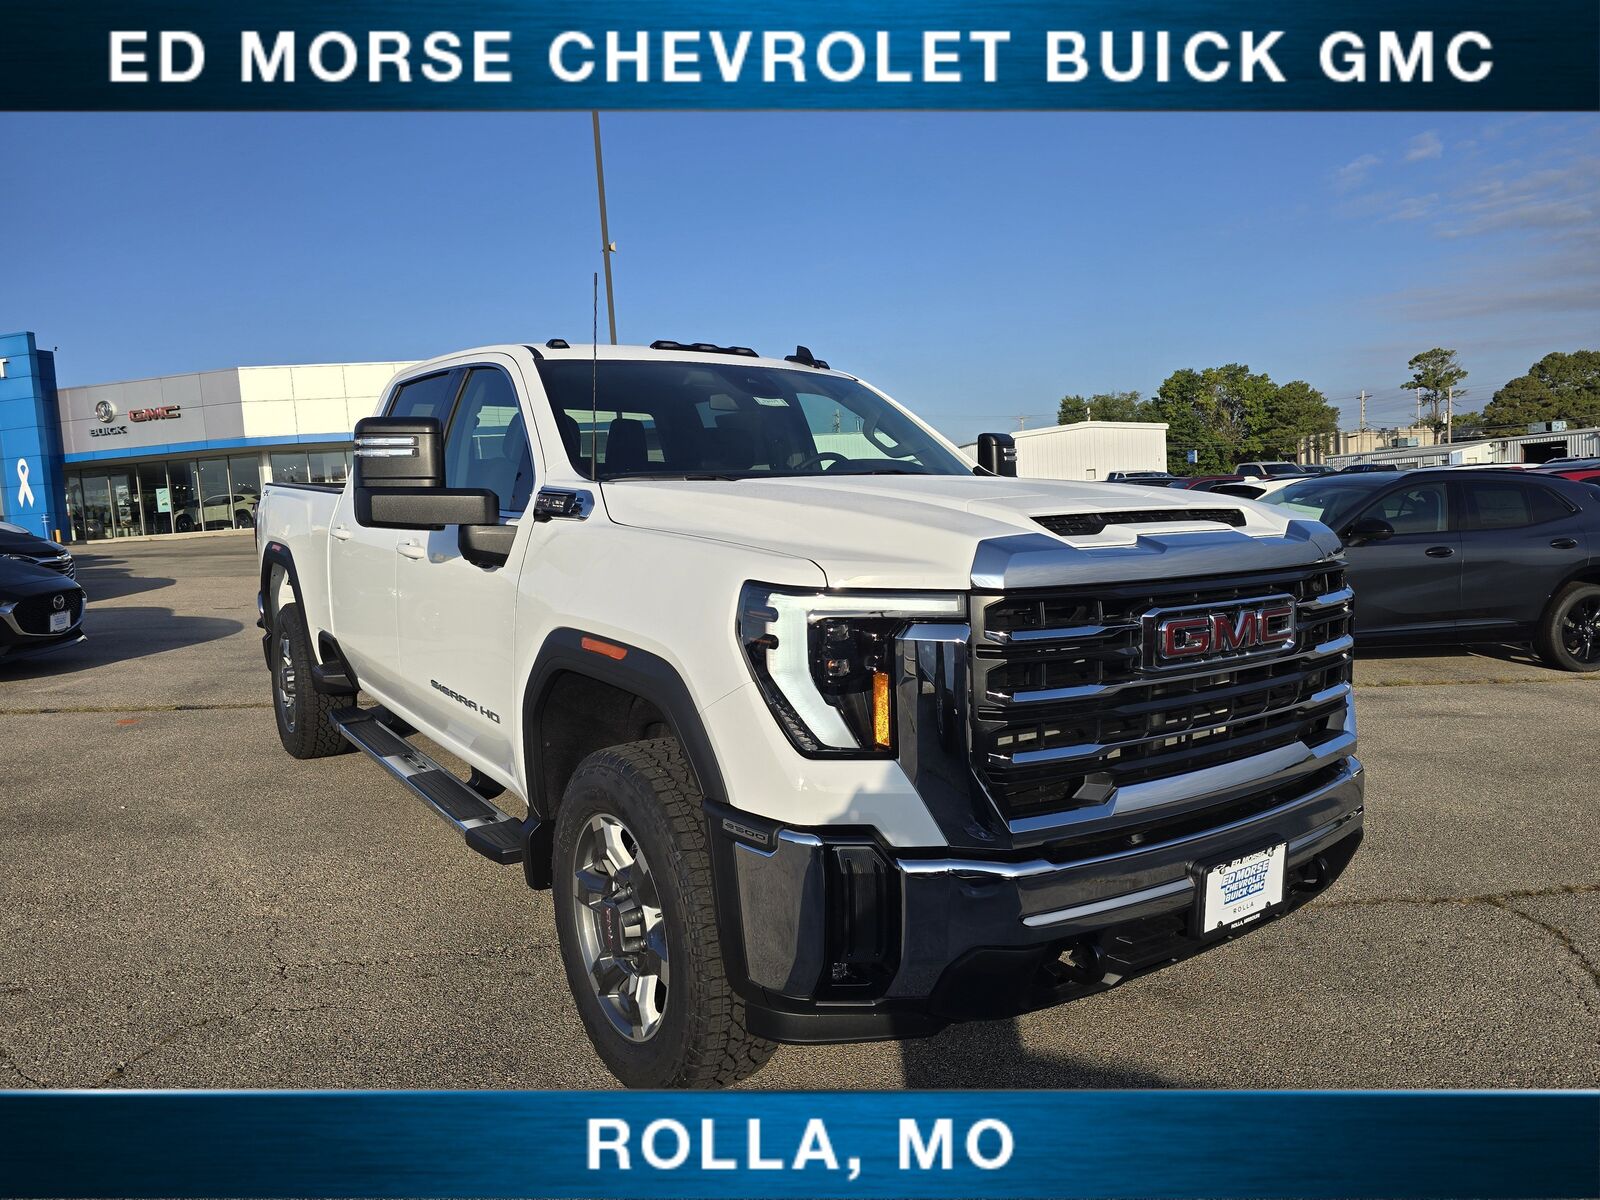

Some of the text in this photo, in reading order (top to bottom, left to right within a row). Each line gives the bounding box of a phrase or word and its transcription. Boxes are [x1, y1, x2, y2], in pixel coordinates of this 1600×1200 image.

[128, 405, 181, 422] GMC
[89, 425, 127, 437] BUICK
[1159, 607, 1293, 660] GMC
[430, 679, 500, 724] SIERRA HD
[1222, 871, 1237, 888] ED
[1236, 859, 1269, 881] MORSE
[1225, 873, 1265, 893] CHEVROLET
[1233, 901, 1253, 912] ROLLA
